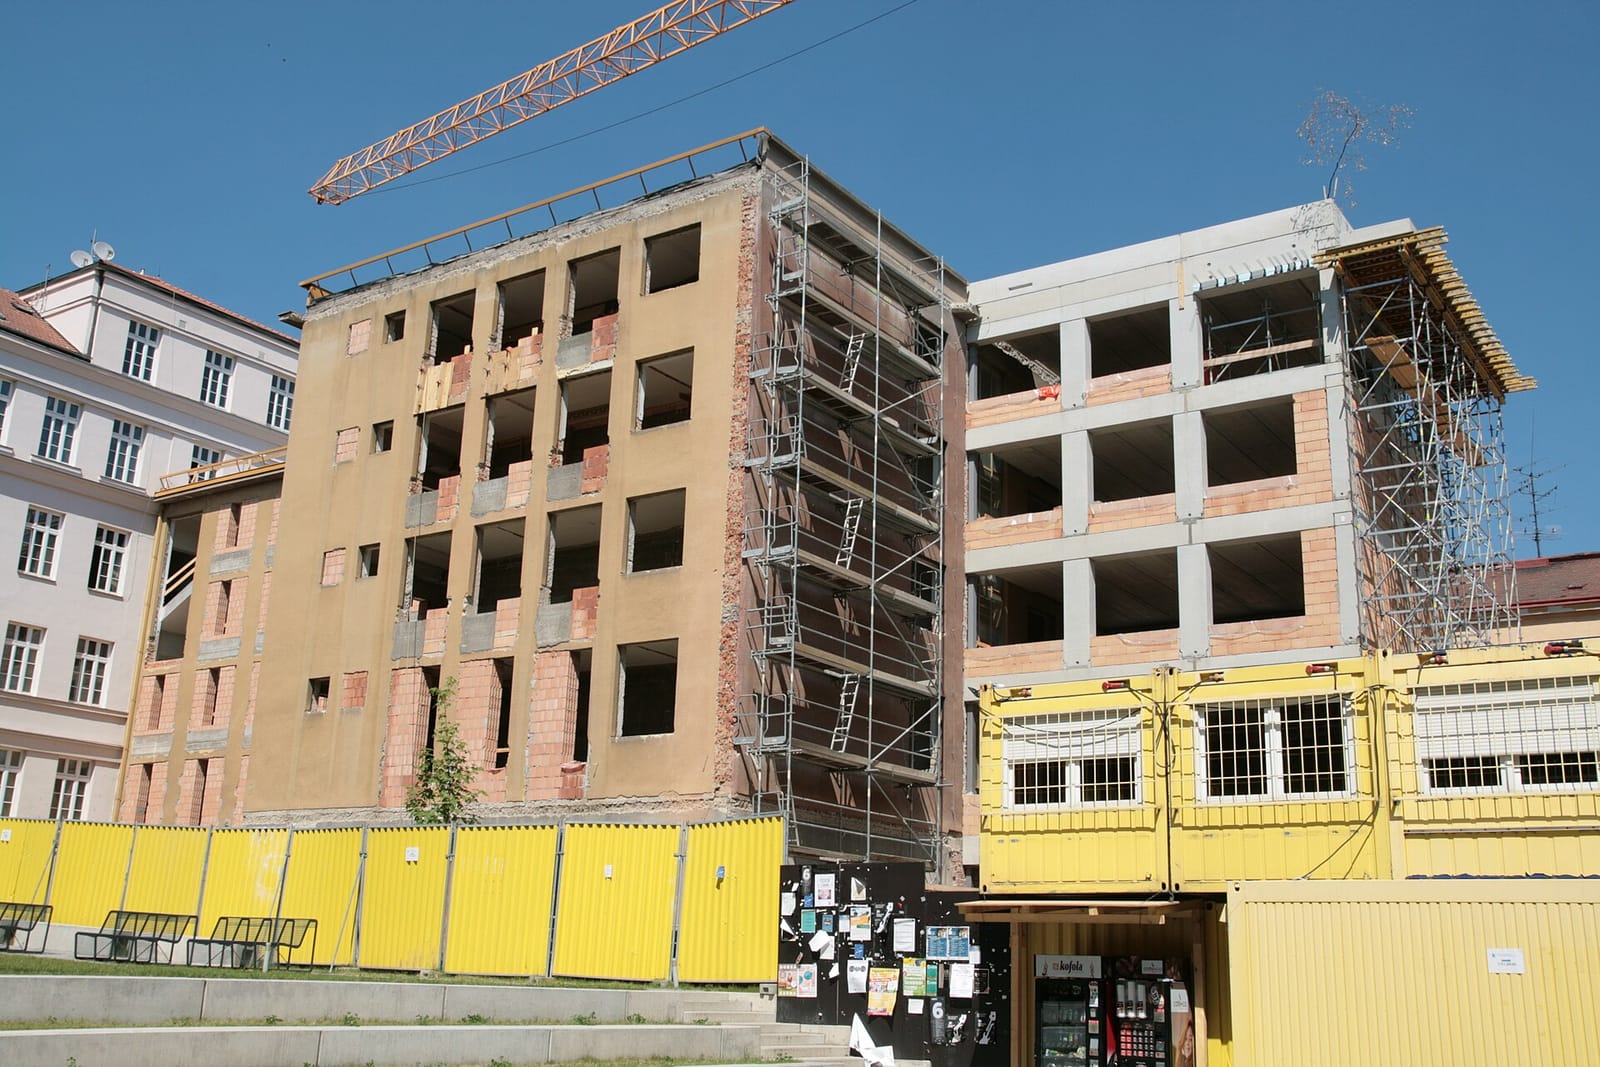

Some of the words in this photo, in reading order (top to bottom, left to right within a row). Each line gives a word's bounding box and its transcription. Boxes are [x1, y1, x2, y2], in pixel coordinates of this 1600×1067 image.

[802, 868, 811, 880] 6
[1059, 960, 1083, 974] kofola
[932, 1002, 943, 1019] 6
